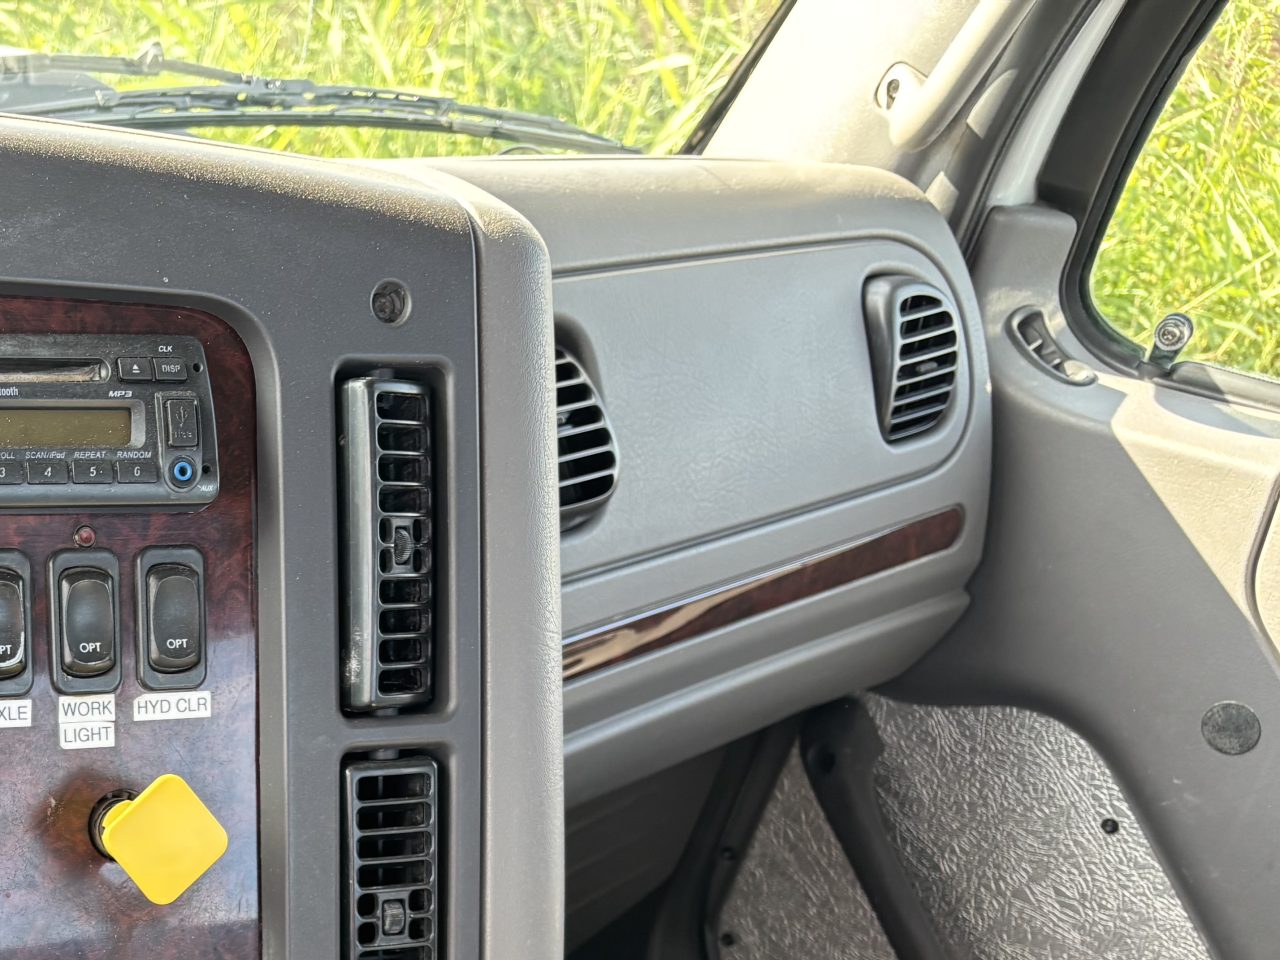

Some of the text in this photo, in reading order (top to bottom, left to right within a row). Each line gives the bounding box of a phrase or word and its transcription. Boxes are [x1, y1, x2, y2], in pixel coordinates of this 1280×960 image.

[158, 345, 173, 353] CLK
[161, 364, 181, 373] DISP
[108, 390, 133, 398] MP3
[25, 451, 66, 460] SCAN/iPod
[73, 450, 106, 459] REPEAT
[116, 450, 152, 459] RANDOM
[0, 466, 7, 478] 3
[44, 466, 52, 477] 4
[89, 466, 97, 477] 5
[200, 484, 214, 492] AUX
[79, 641, 102, 653] OPT
[166, 638, 189, 649] OPT
[61, 700, 113, 717] WORK
[137, 697, 209, 714] HYD CLR
[63, 726, 113, 743] LIGHT
